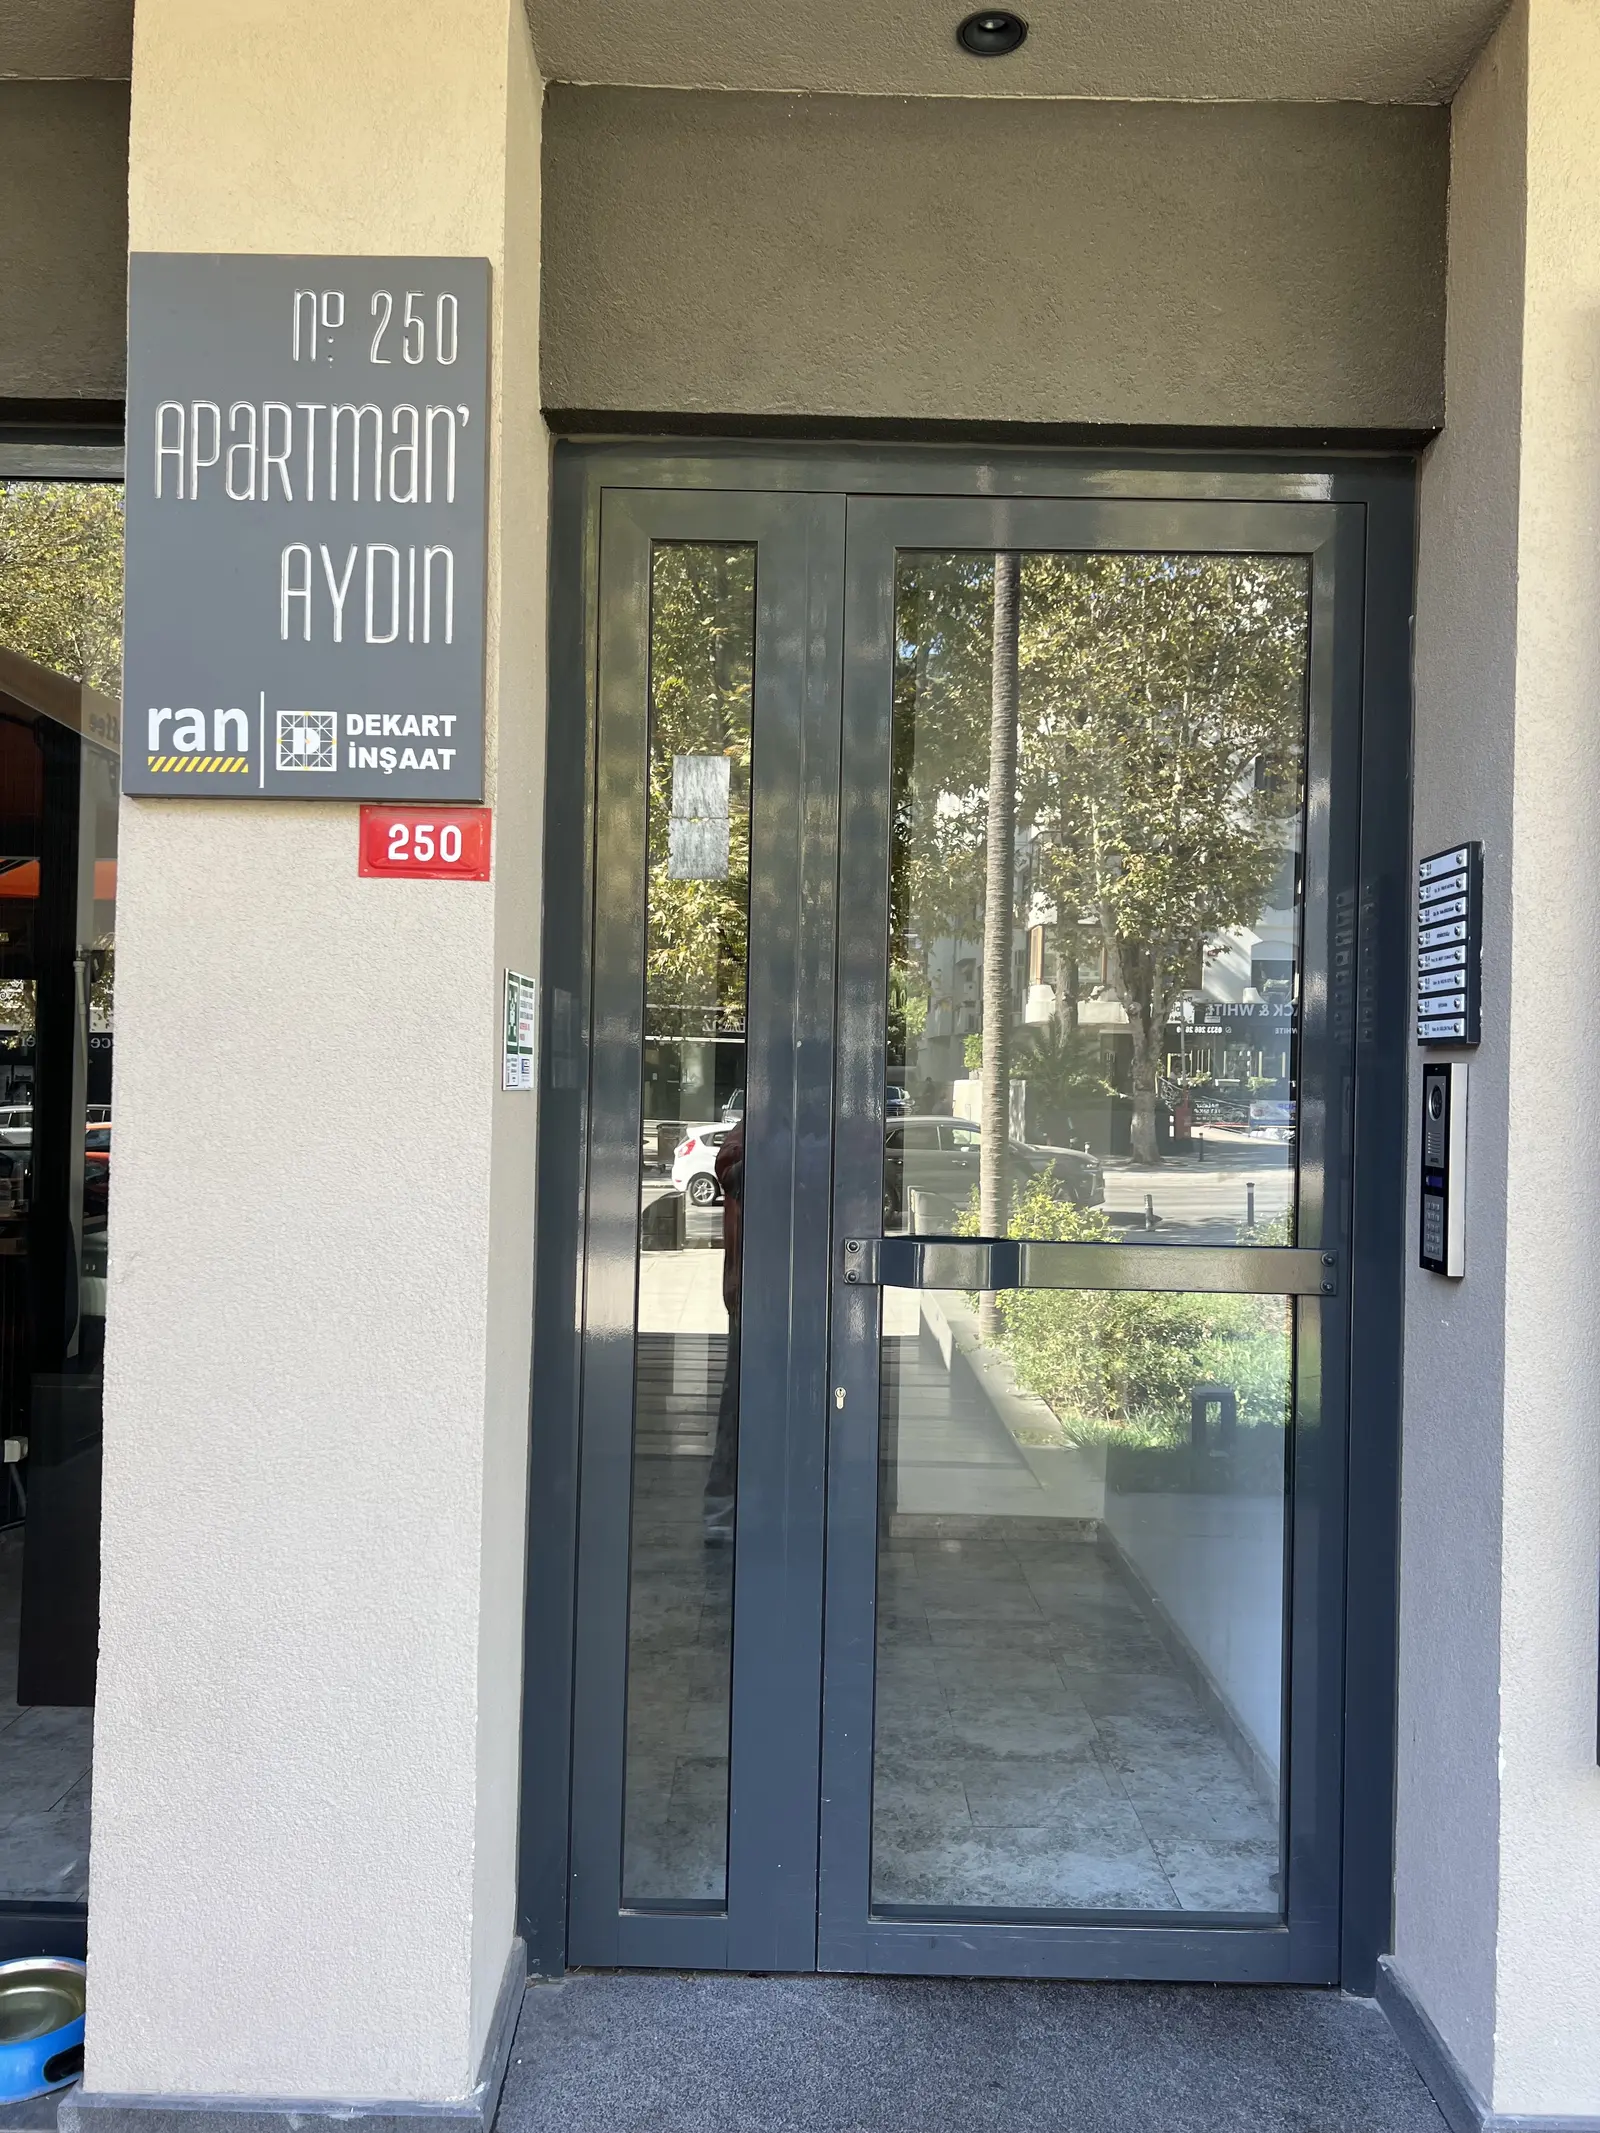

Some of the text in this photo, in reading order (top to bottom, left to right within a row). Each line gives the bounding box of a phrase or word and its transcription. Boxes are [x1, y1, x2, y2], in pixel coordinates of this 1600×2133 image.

[370, 290, 458, 365] 250
[148, 707, 249, 752] ran
[346, 713, 457, 737] DEKART
[348, 742, 457, 775] İNŞAAT
[388, 824, 462, 862] 250
